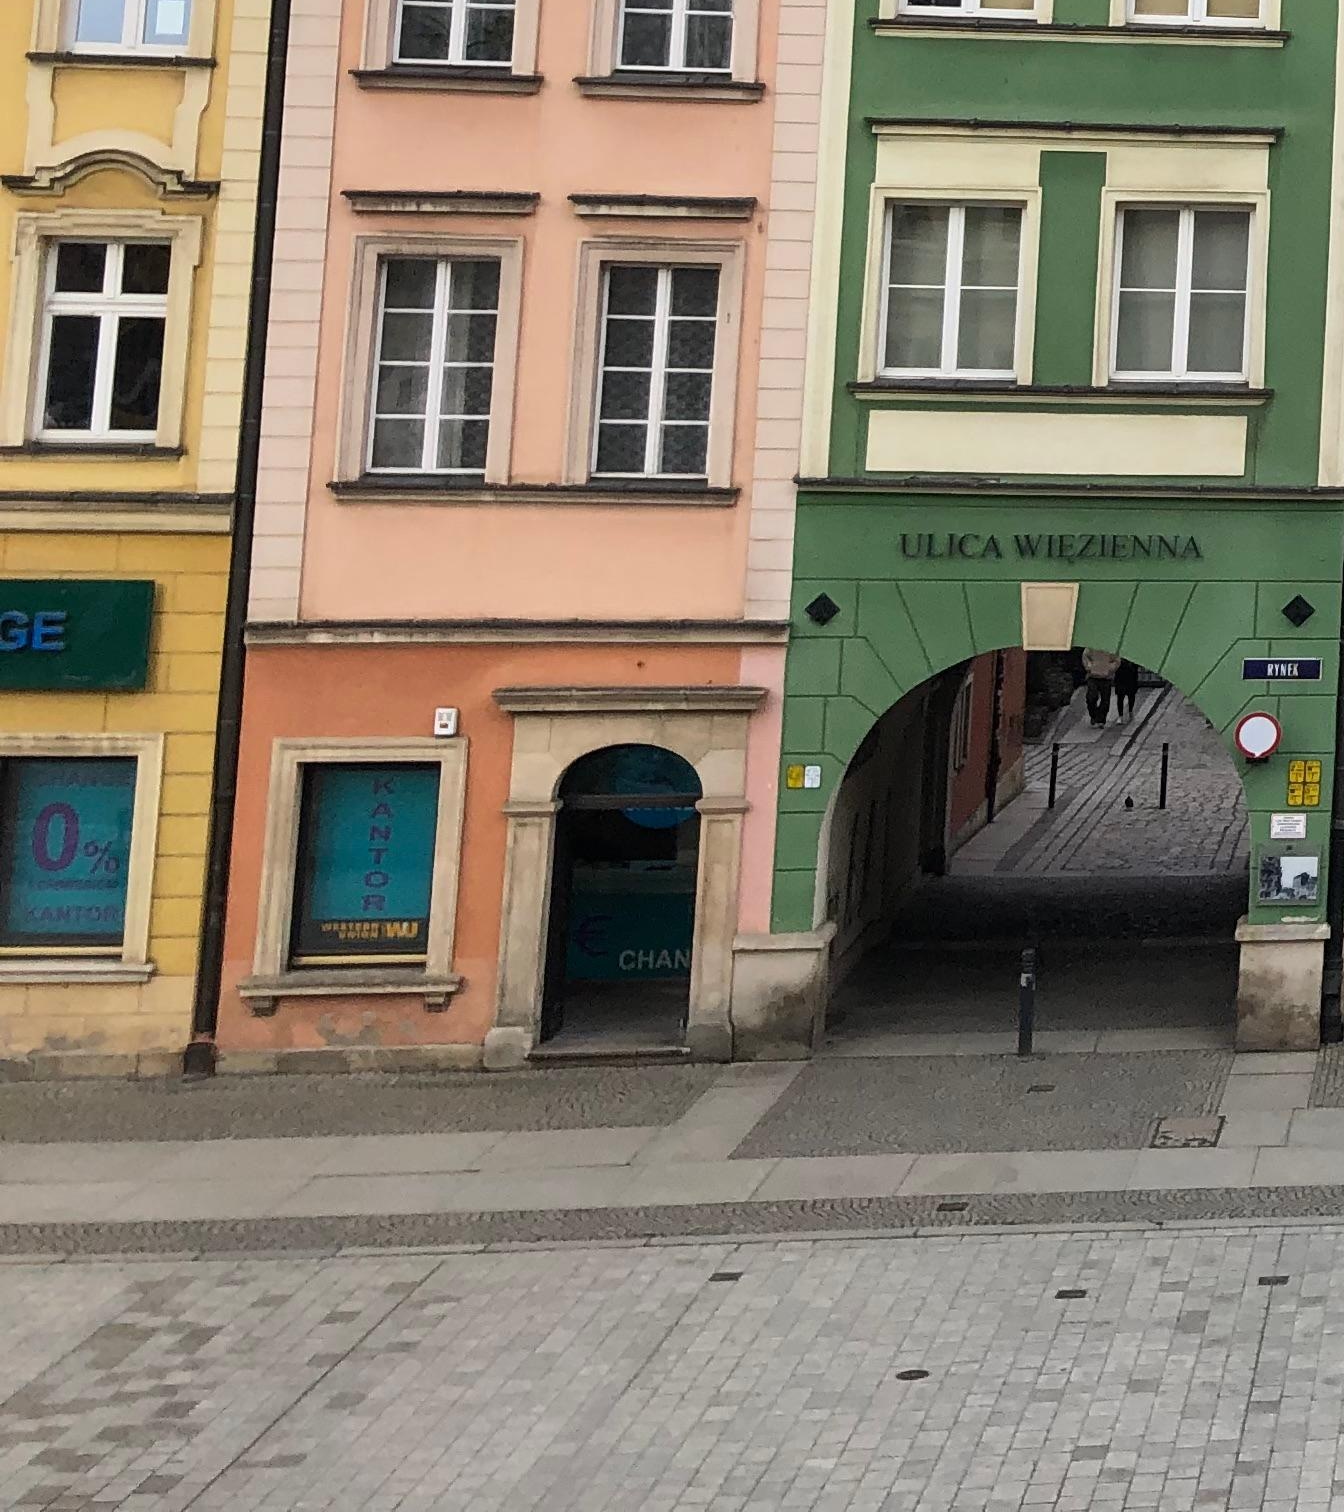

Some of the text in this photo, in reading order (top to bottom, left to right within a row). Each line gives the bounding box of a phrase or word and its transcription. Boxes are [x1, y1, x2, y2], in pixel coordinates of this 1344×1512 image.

[899, 532, 1204, 564] ULICA WIĘZIENNA
[1266, 662, 1300, 678] RYNEK
[361, 777, 396, 913] KANTOR
